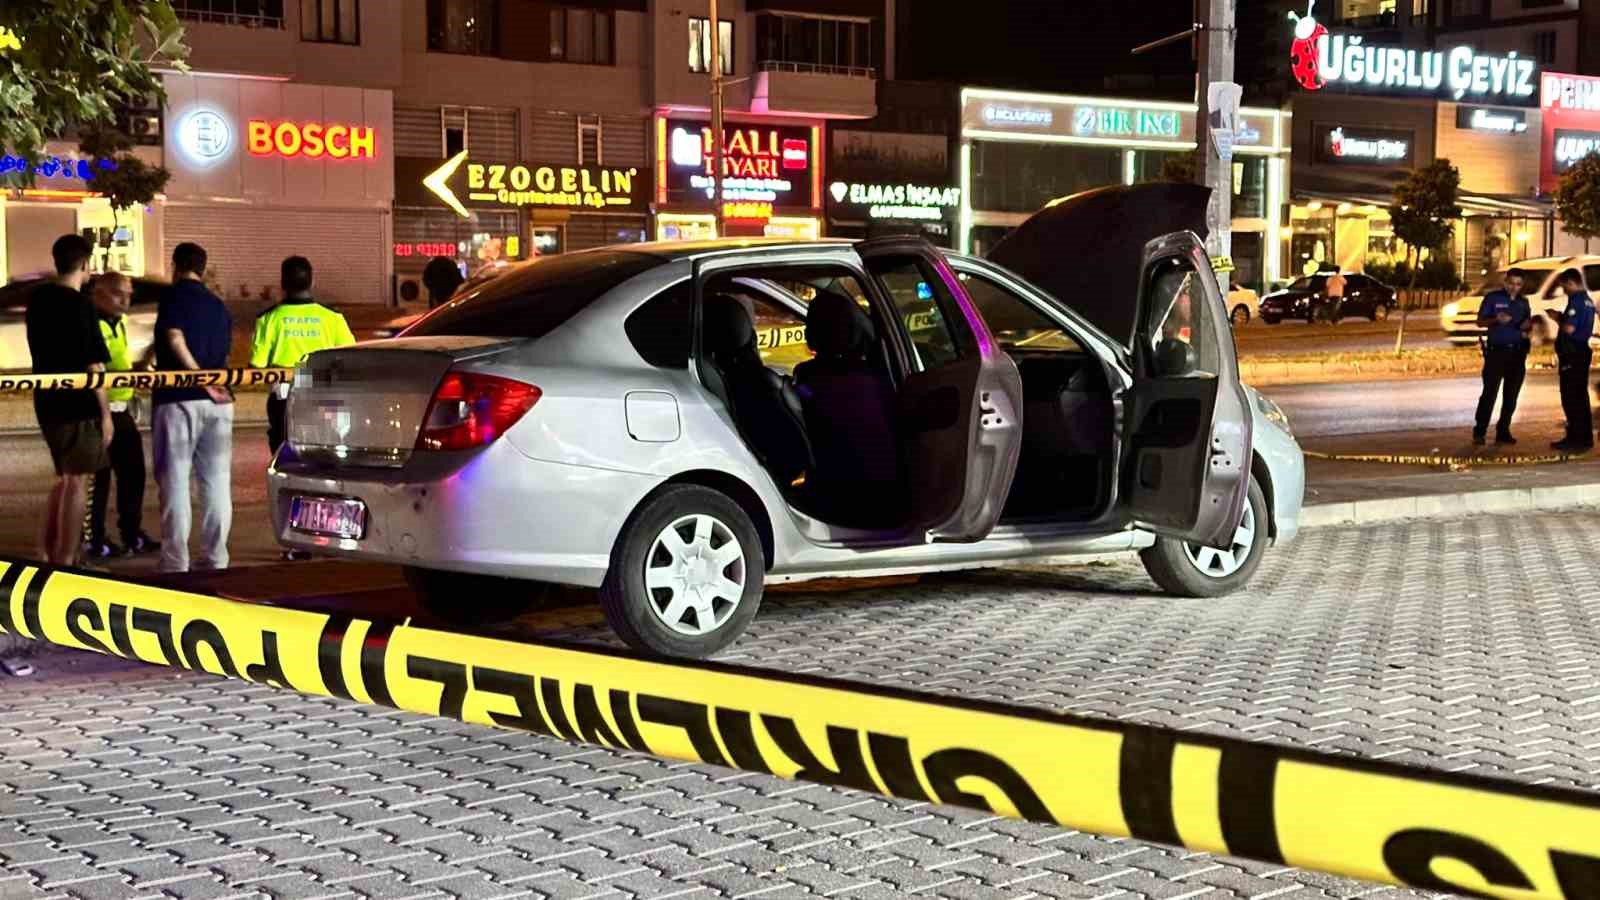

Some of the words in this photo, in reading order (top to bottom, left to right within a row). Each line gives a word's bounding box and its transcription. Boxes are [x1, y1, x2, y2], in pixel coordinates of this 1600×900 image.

[1318, 35, 1444, 89] UĞURLU
[1449, 46, 1536, 100] ÇEYİZ
[249, 121, 375, 159] BOSCH
[850, 184, 905, 205] ELMAS
